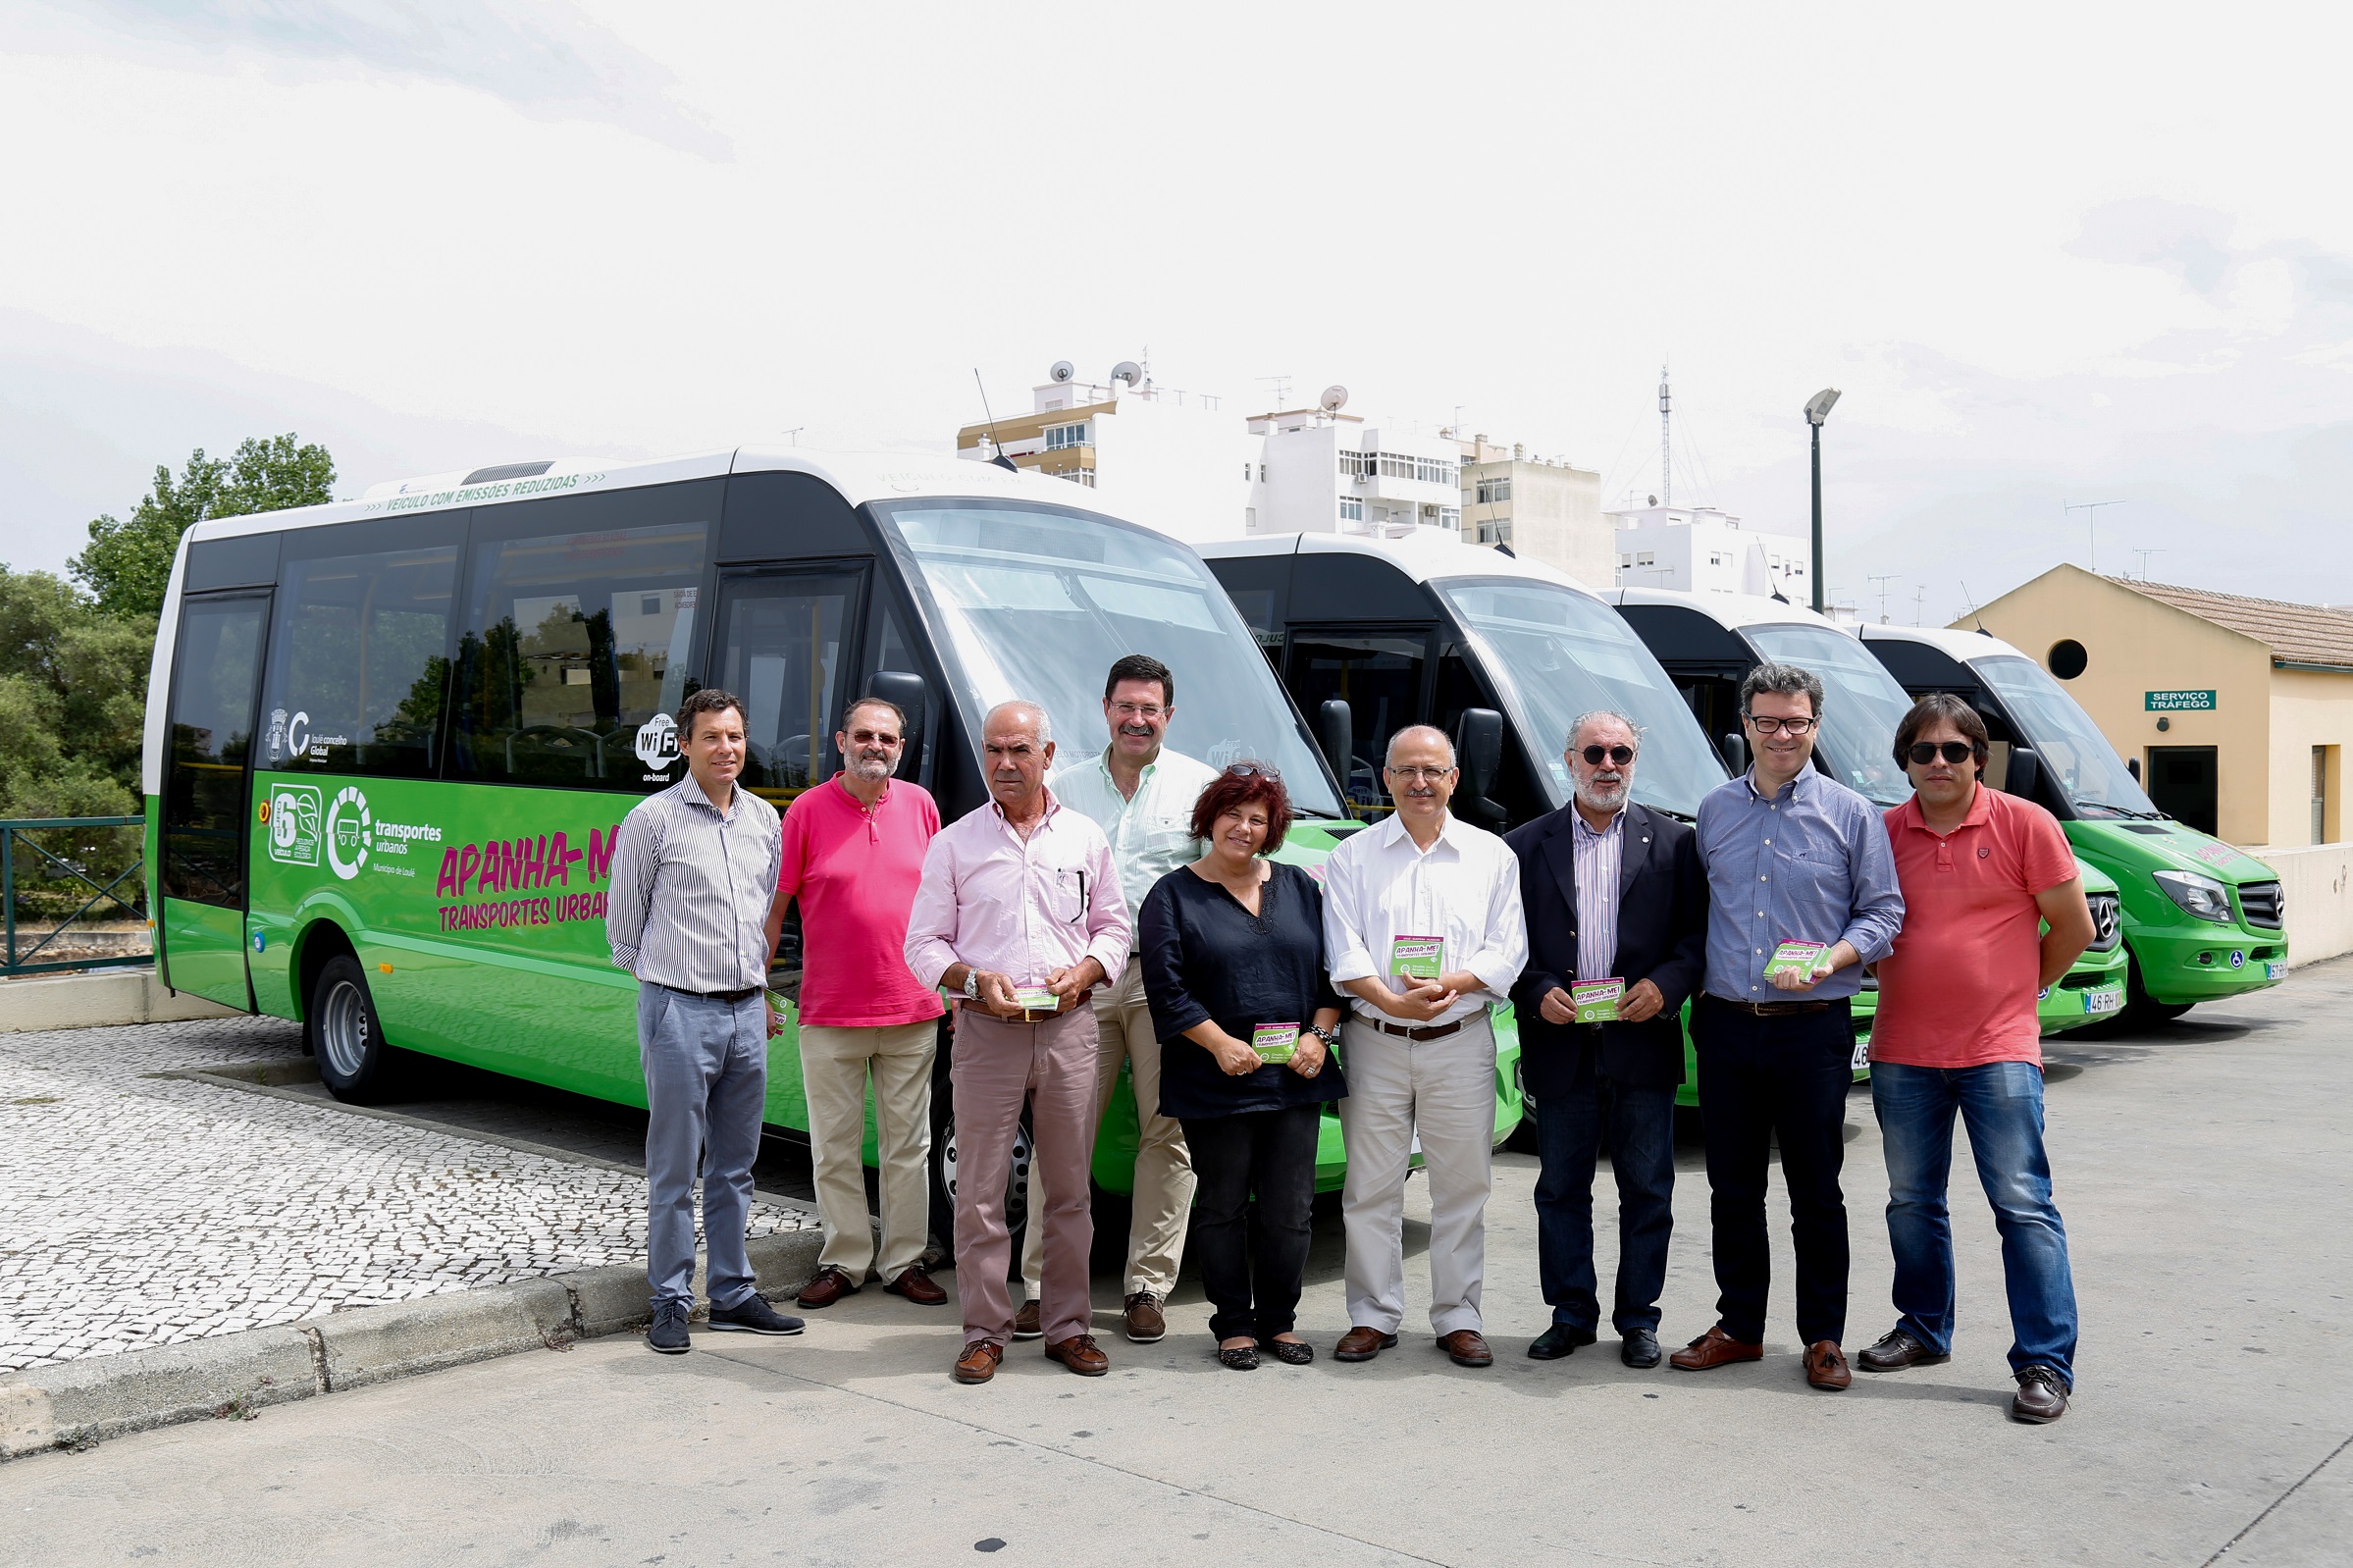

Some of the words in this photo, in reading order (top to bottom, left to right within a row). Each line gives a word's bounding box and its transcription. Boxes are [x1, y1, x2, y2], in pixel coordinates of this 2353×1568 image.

[430, 489, 456, 505] COM
[455, 484, 512, 503] EMISSÕES
[511, 474, 579, 497] REDUZIDAS
[2153, 692, 2208, 702] SERVIÇO
[2151, 700, 2210, 708] TRÁFEGO
[654, 717, 670, 727] Free
[323, 735, 347, 746] concelho
[310, 746, 329, 757] Global
[643, 773, 670, 782] on-board
[375, 819, 442, 842] transportes
[376, 839, 408, 855] urbanos
[395, 866, 402, 875] de
[439, 897, 549, 932] TRANSPORTES
